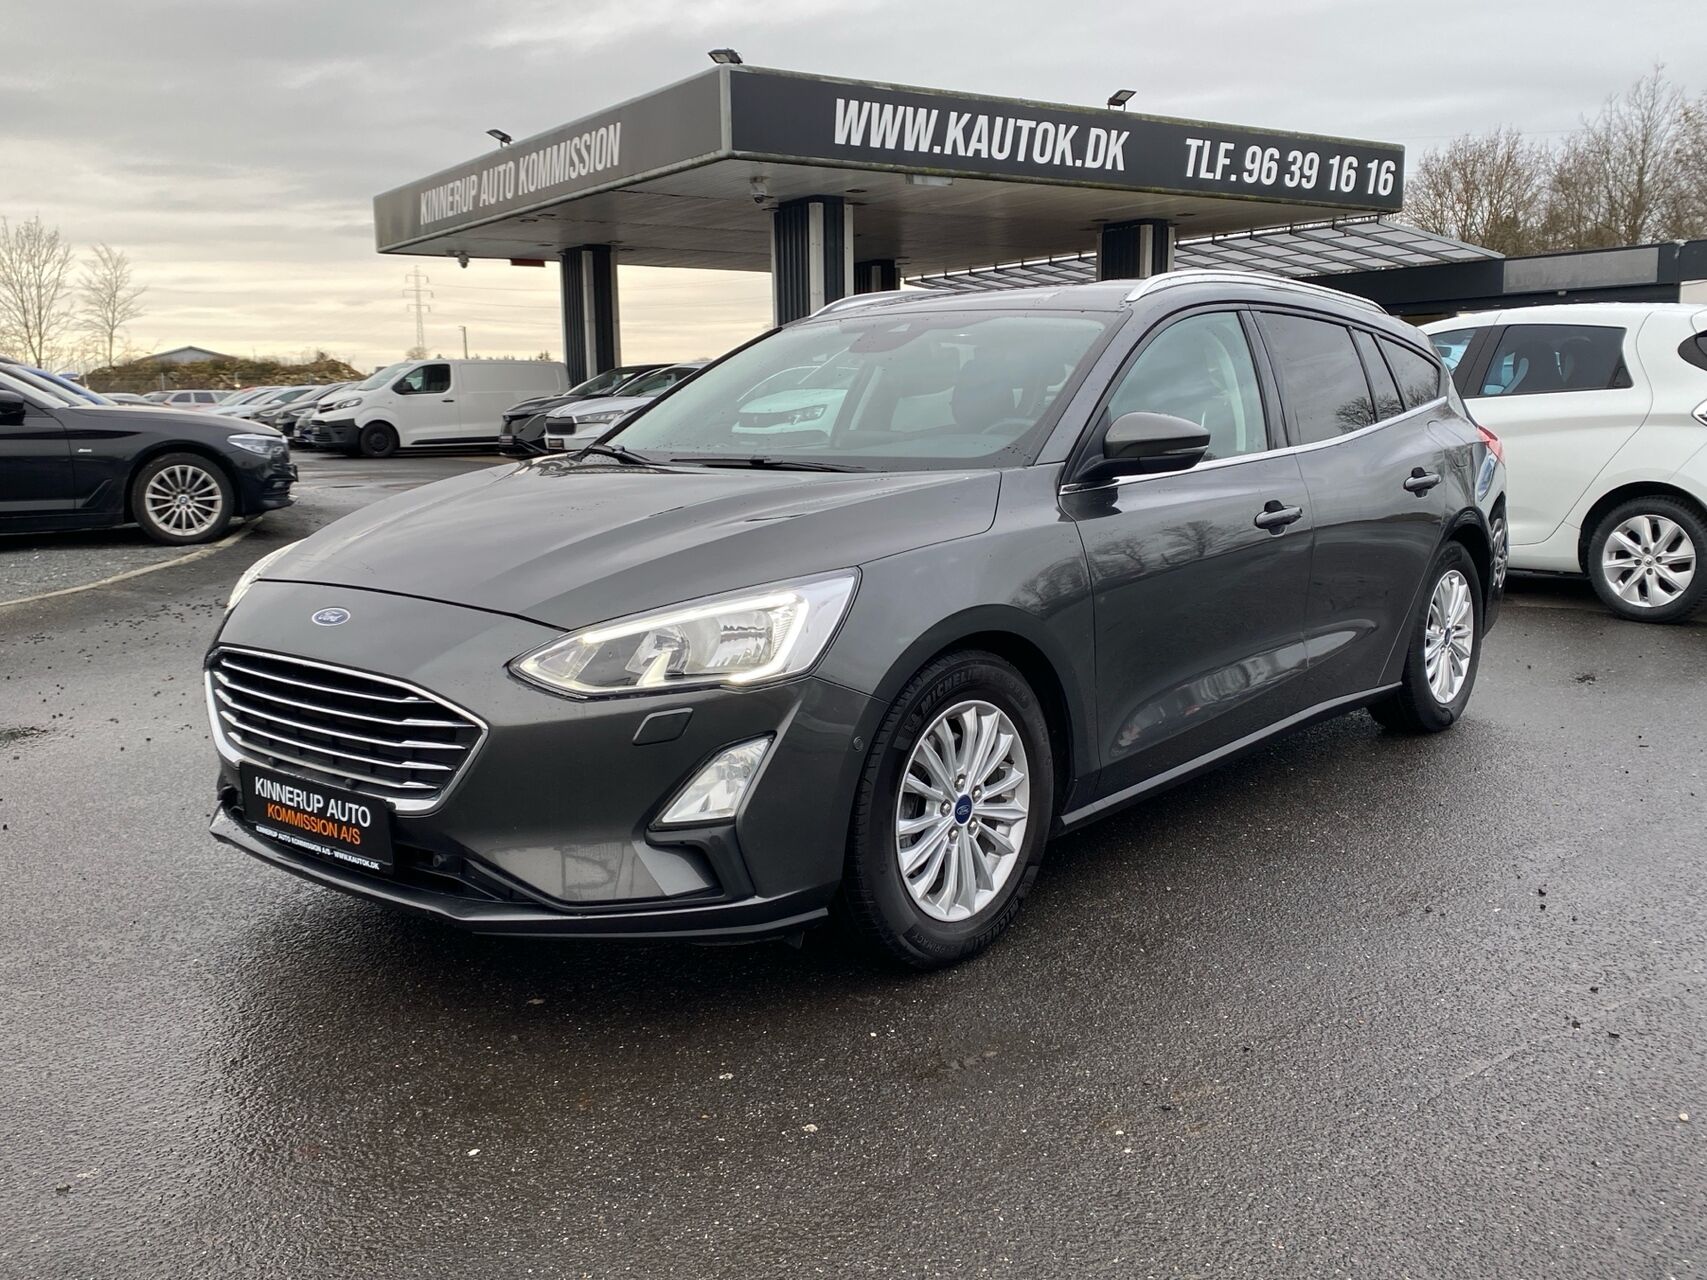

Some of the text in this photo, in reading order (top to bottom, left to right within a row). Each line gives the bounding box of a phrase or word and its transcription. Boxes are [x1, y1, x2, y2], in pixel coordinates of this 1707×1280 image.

[834, 98, 1130, 171] WWW.KAUTOK.DK
[420, 122, 621, 225] KINNERUP AUTO KOMMISSION
[1185, 138, 1396, 196] TLF. 96 39 16 16
[255, 776, 371, 827] KINNERUP AUTO
[267, 803, 361, 845] KOMMISSION A/S
